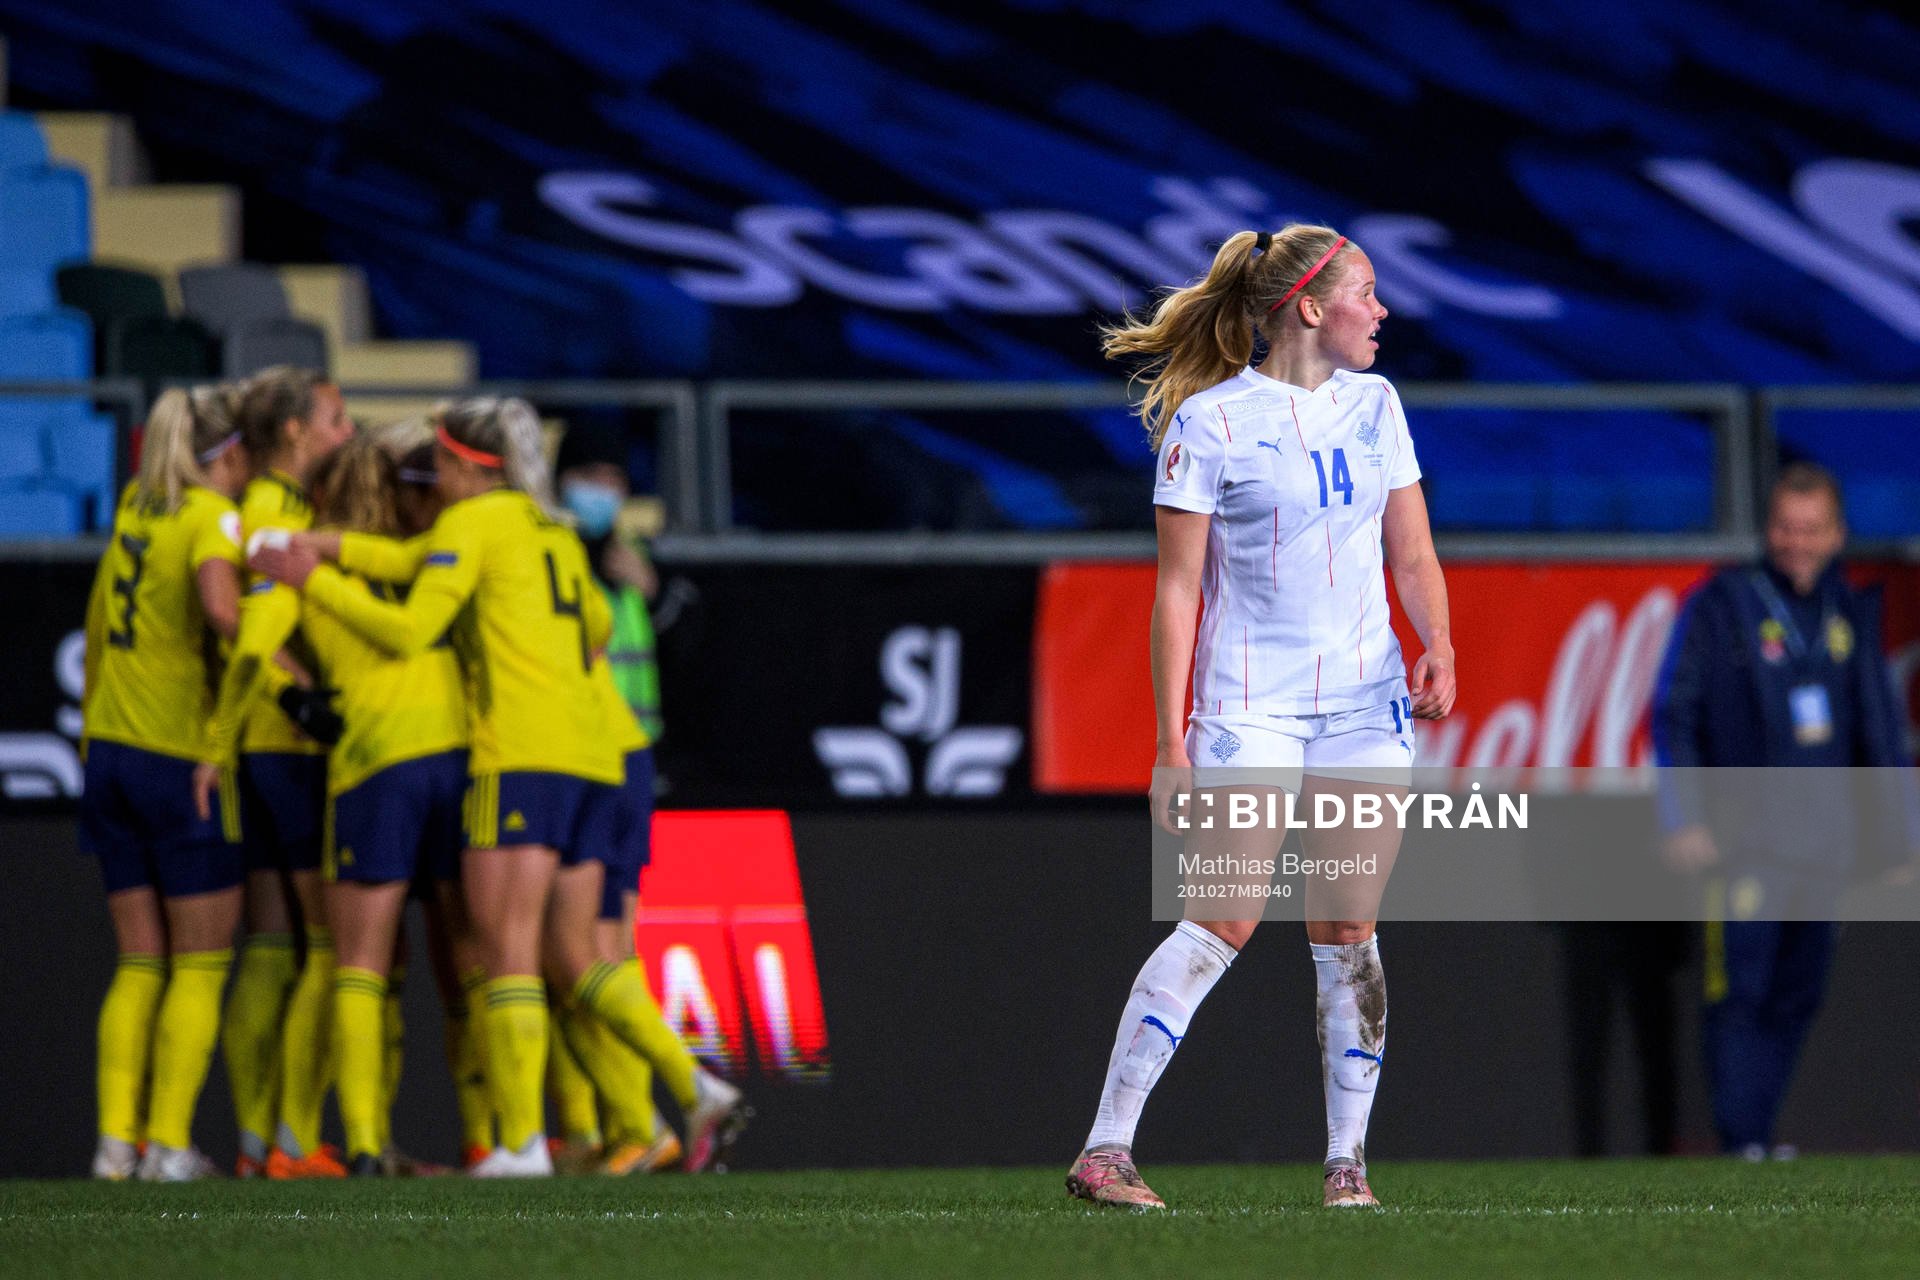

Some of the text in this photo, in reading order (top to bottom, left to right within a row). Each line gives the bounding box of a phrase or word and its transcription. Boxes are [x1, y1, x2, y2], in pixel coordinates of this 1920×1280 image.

[1310, 448, 1354, 508] 14
[109, 533, 149, 649] 3
[544, 549, 592, 676] 4
[879, 622, 962, 742] SJ
